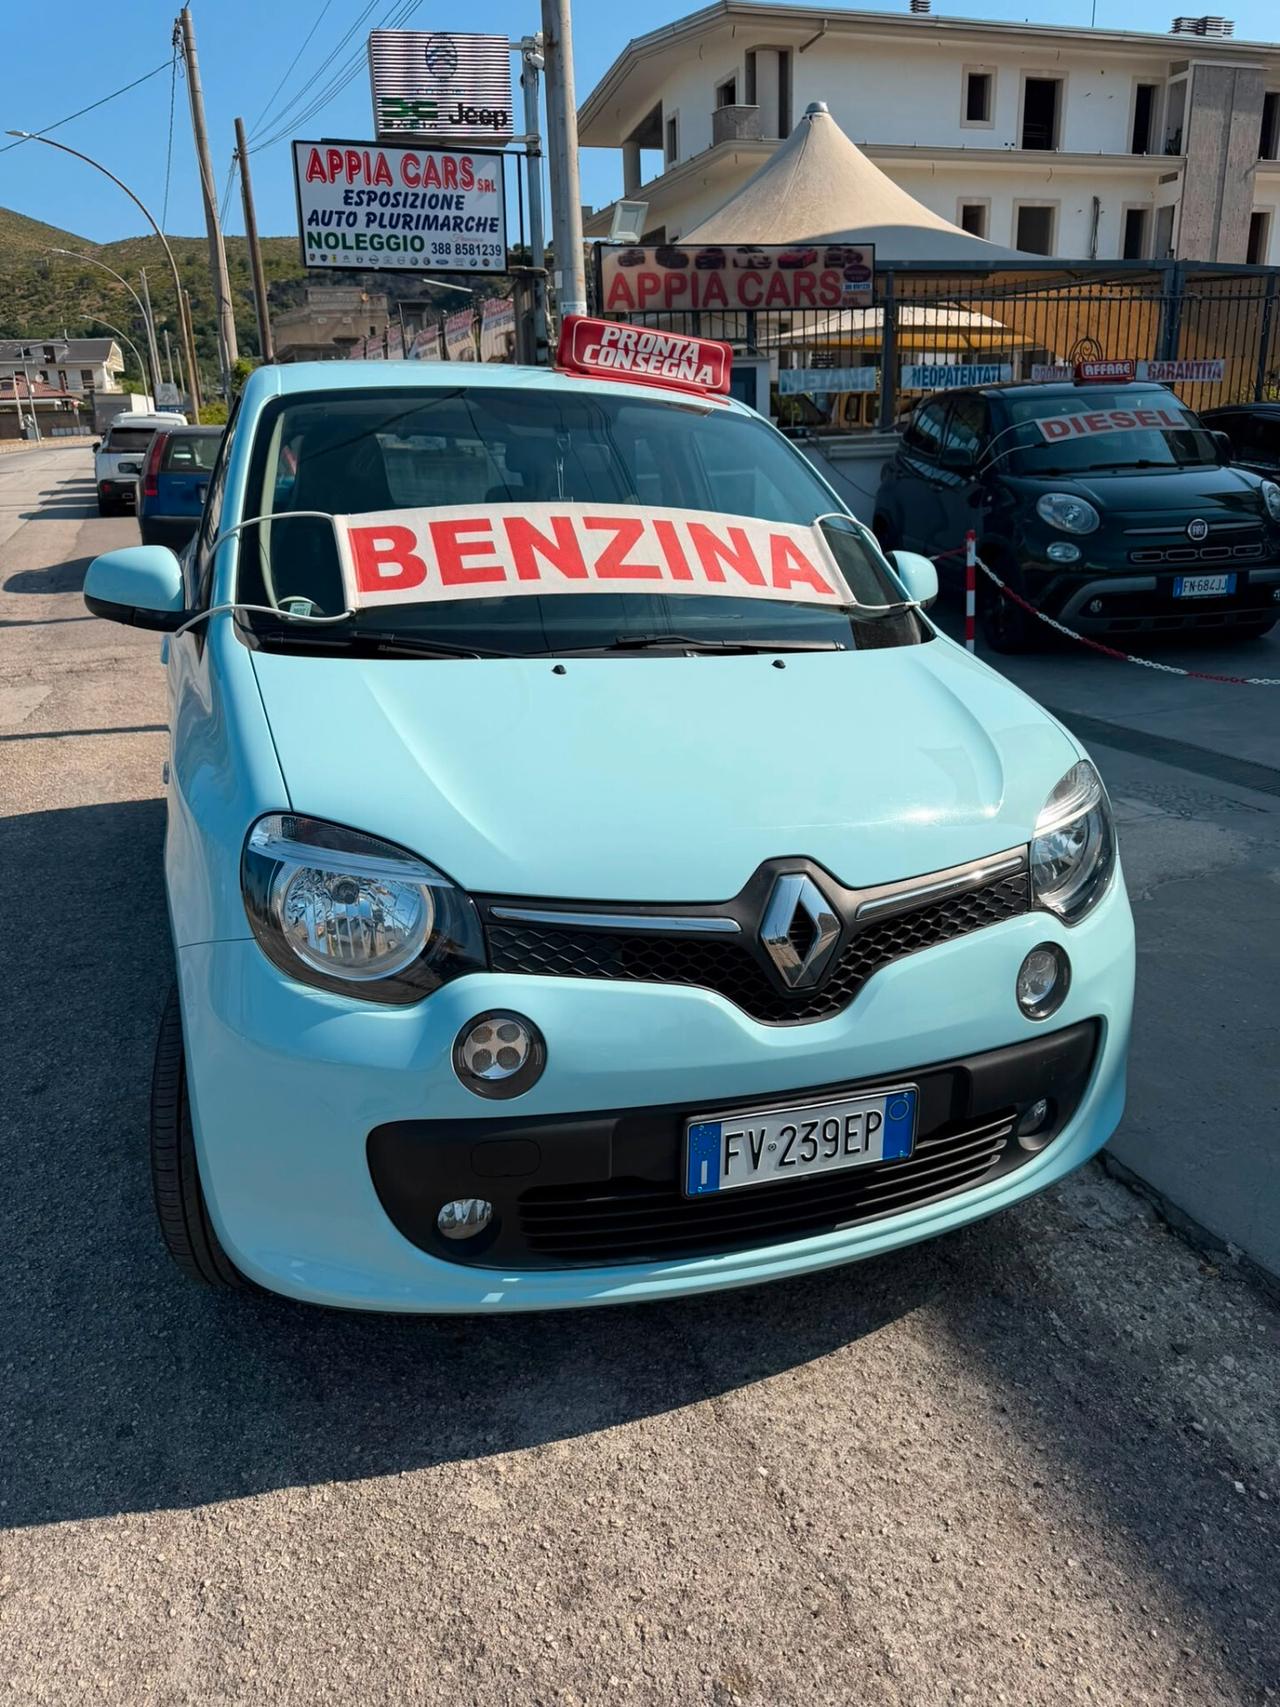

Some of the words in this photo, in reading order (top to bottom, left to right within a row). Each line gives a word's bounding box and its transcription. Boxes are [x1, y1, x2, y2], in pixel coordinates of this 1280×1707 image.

[448, 103, 507, 130] Jeep
[305, 148, 393, 187] APPIA
[400, 153, 475, 192] CARS
[477, 180, 497, 192] SRL
[343, 189, 465, 211] ESPOSIZIONE
[307, 209, 358, 228] AUTO
[365, 211, 499, 233] PLURIMARCHE
[307, 231, 425, 252] NOLEGGIO
[431, 242, 451, 255] 388
[455, 243, 502, 256] 8581239
[607, 271, 729, 310] APPIA
[737, 270, 843, 308] CARS
[601, 326, 700, 363] PRONTA
[582, 344, 713, 385] CONSEGNA
[1085, 363, 1130, 376] AFFARE
[1147, 360, 1222, 380] GARANTITA
[1041, 409, 1185, 440] DIESEL
[347, 516, 835, 595] BENZINA
